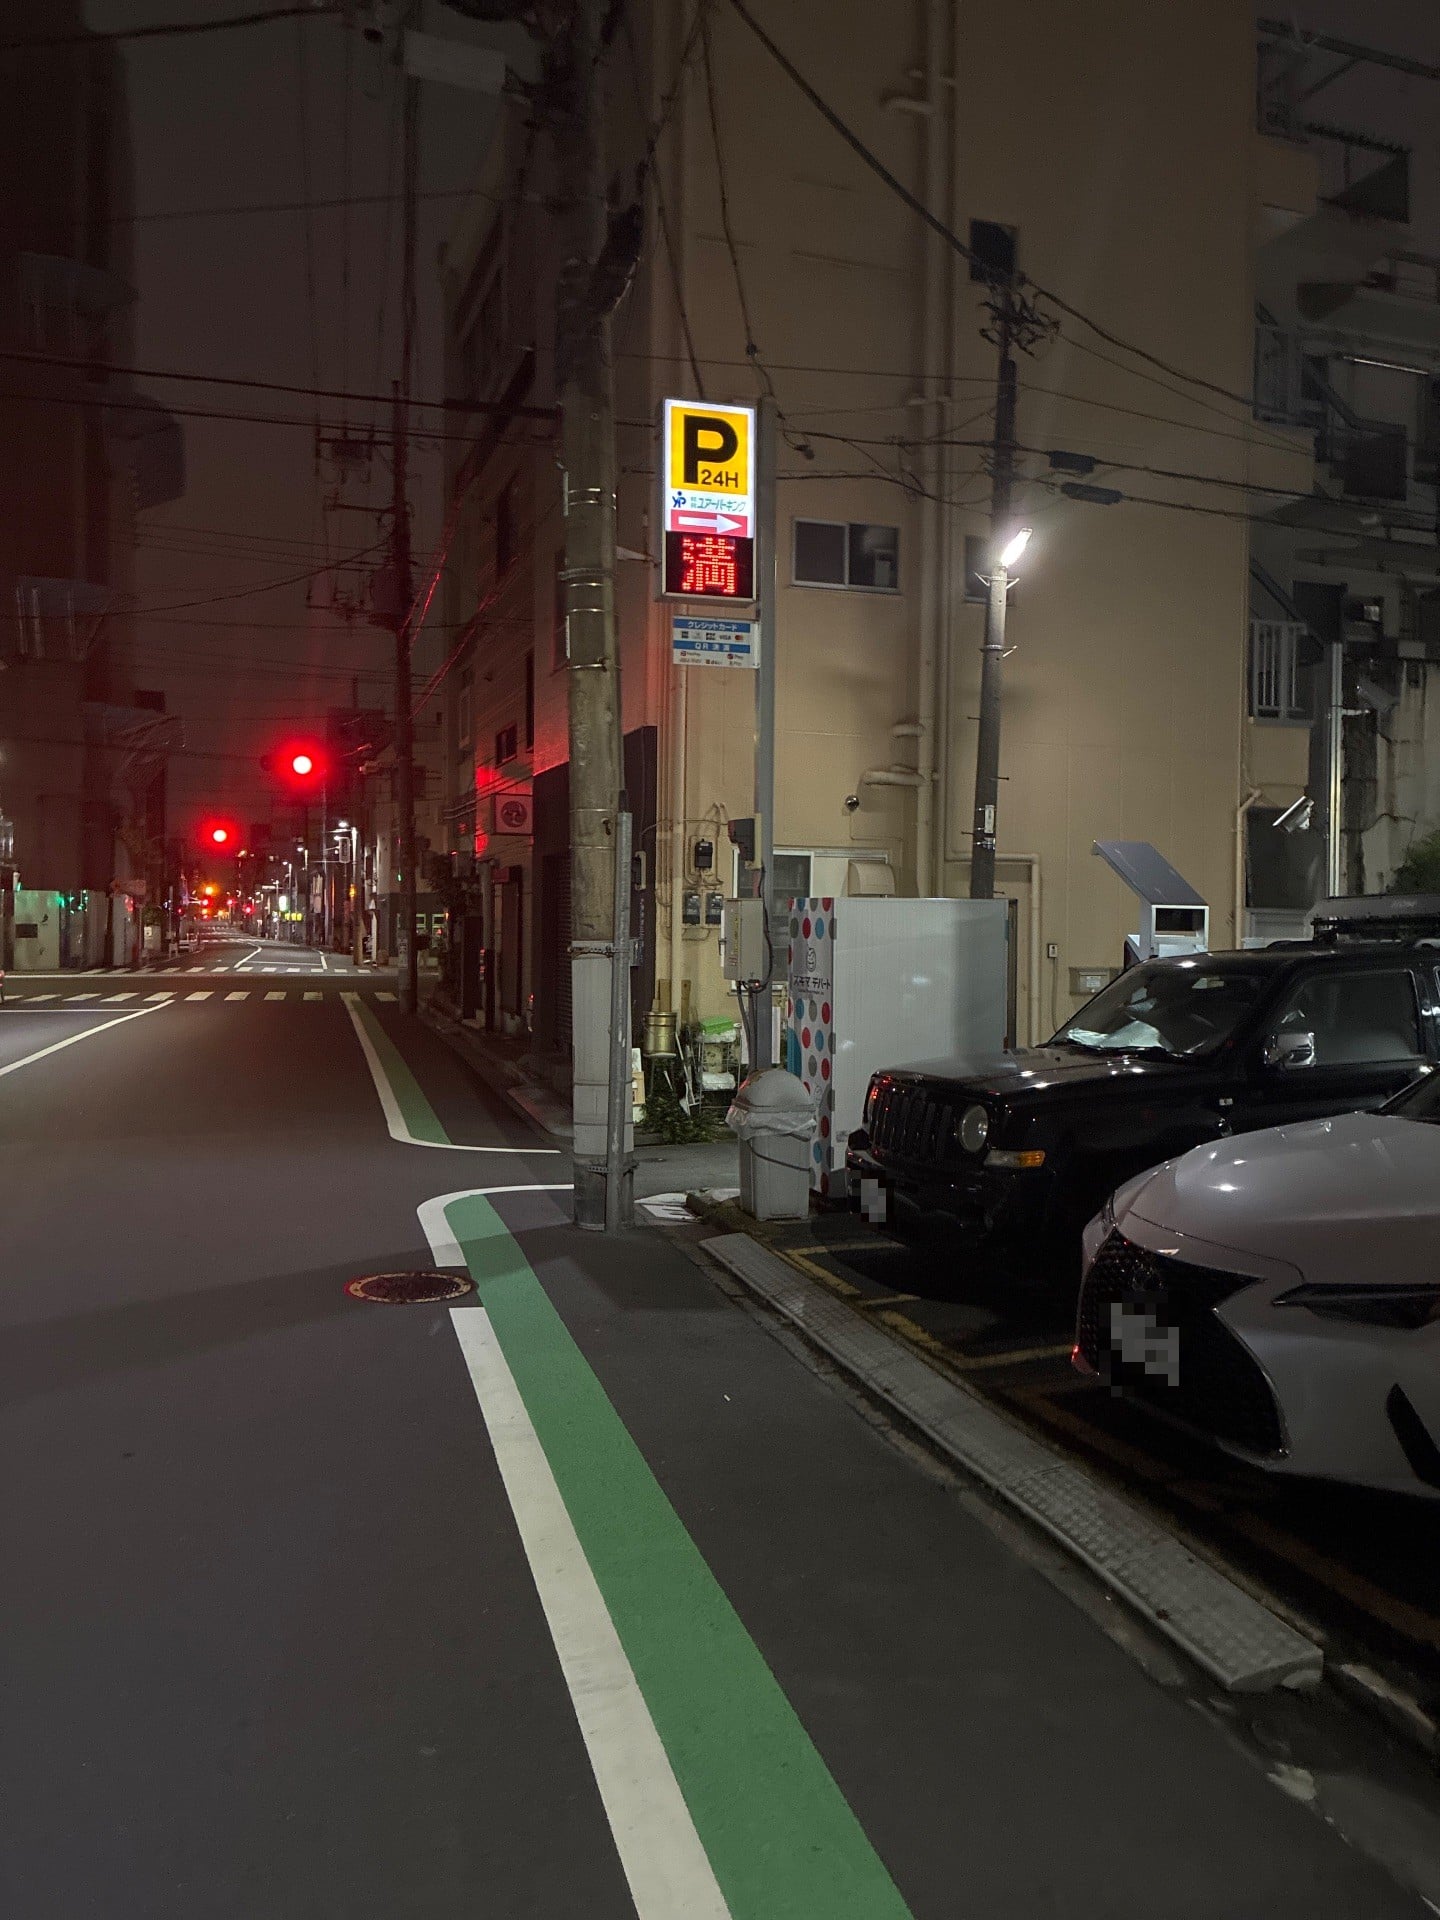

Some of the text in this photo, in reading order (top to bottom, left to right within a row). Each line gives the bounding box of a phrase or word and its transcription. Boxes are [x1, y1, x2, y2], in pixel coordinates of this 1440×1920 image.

[684, 414, 739, 485] P
[701, 468, 739, 488] 24H
[682, 537, 735, 593] 満
[688, 620, 738, 632] クレジットカード
